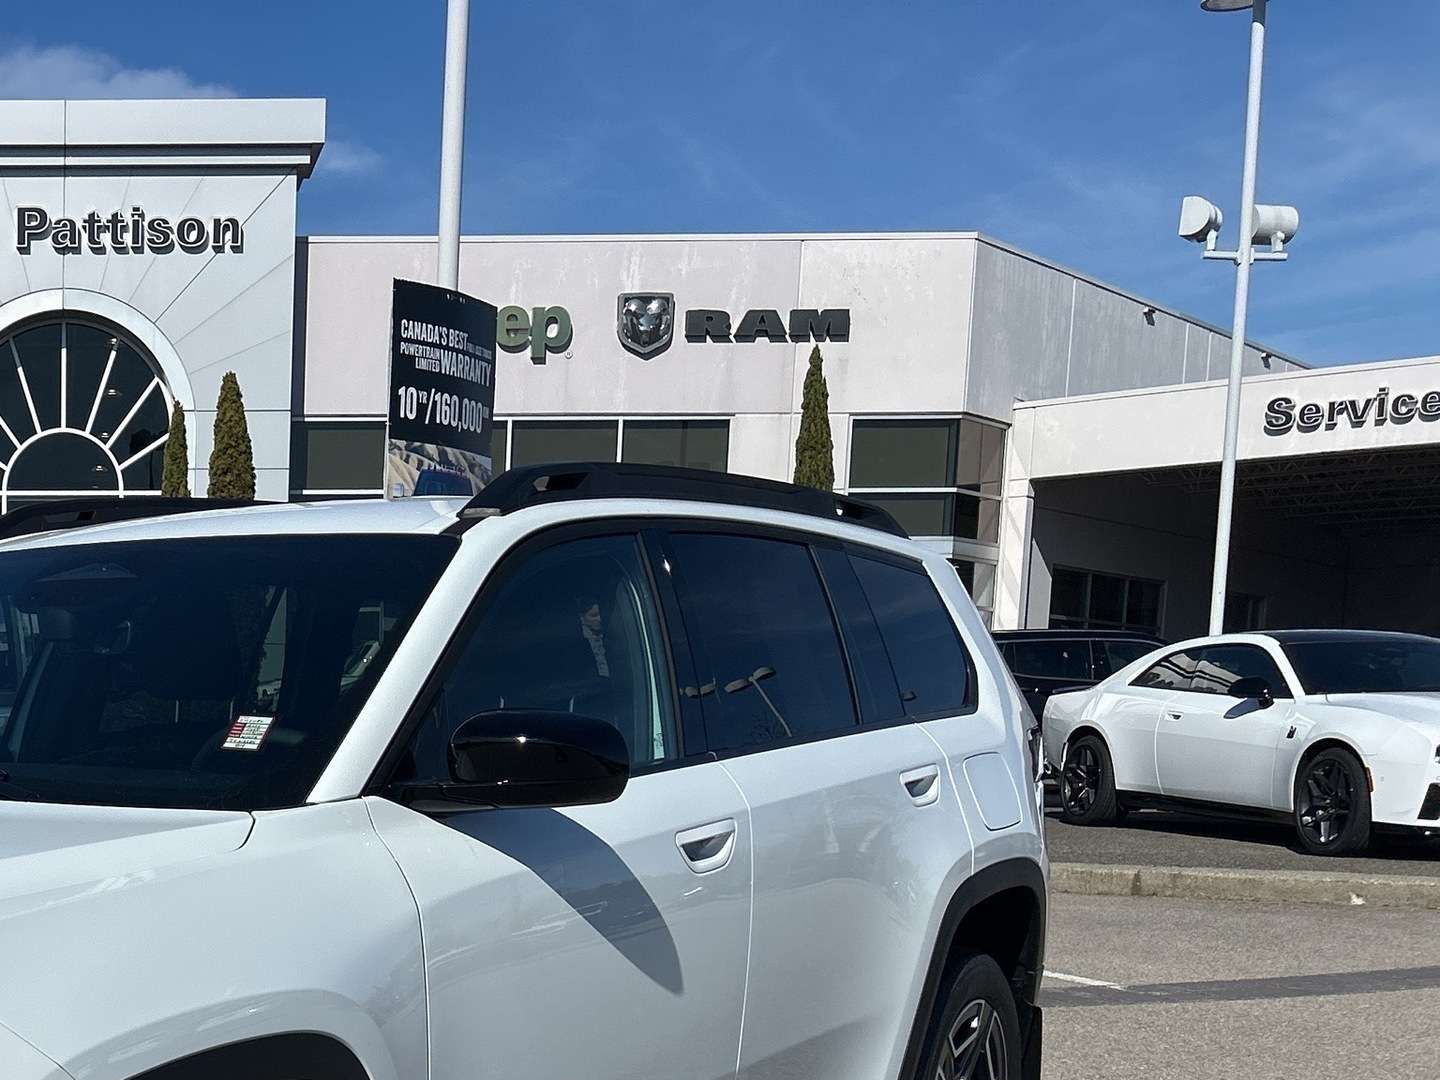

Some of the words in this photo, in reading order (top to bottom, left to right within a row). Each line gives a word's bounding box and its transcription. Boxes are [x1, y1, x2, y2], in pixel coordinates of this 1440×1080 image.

[15, 204, 244, 256] Pattison
[401, 319, 448, 346] CANADA'S
[448, 328, 469, 351] BEST
[496, 304, 573, 364] ep
[684, 308, 850, 343] RAM
[400, 341, 440, 361] POWERTRAIN
[415, 357, 441, 373] LIMITED
[440, 349, 492, 387] WARRANTY
[1263, 386, 1440, 437] Service
